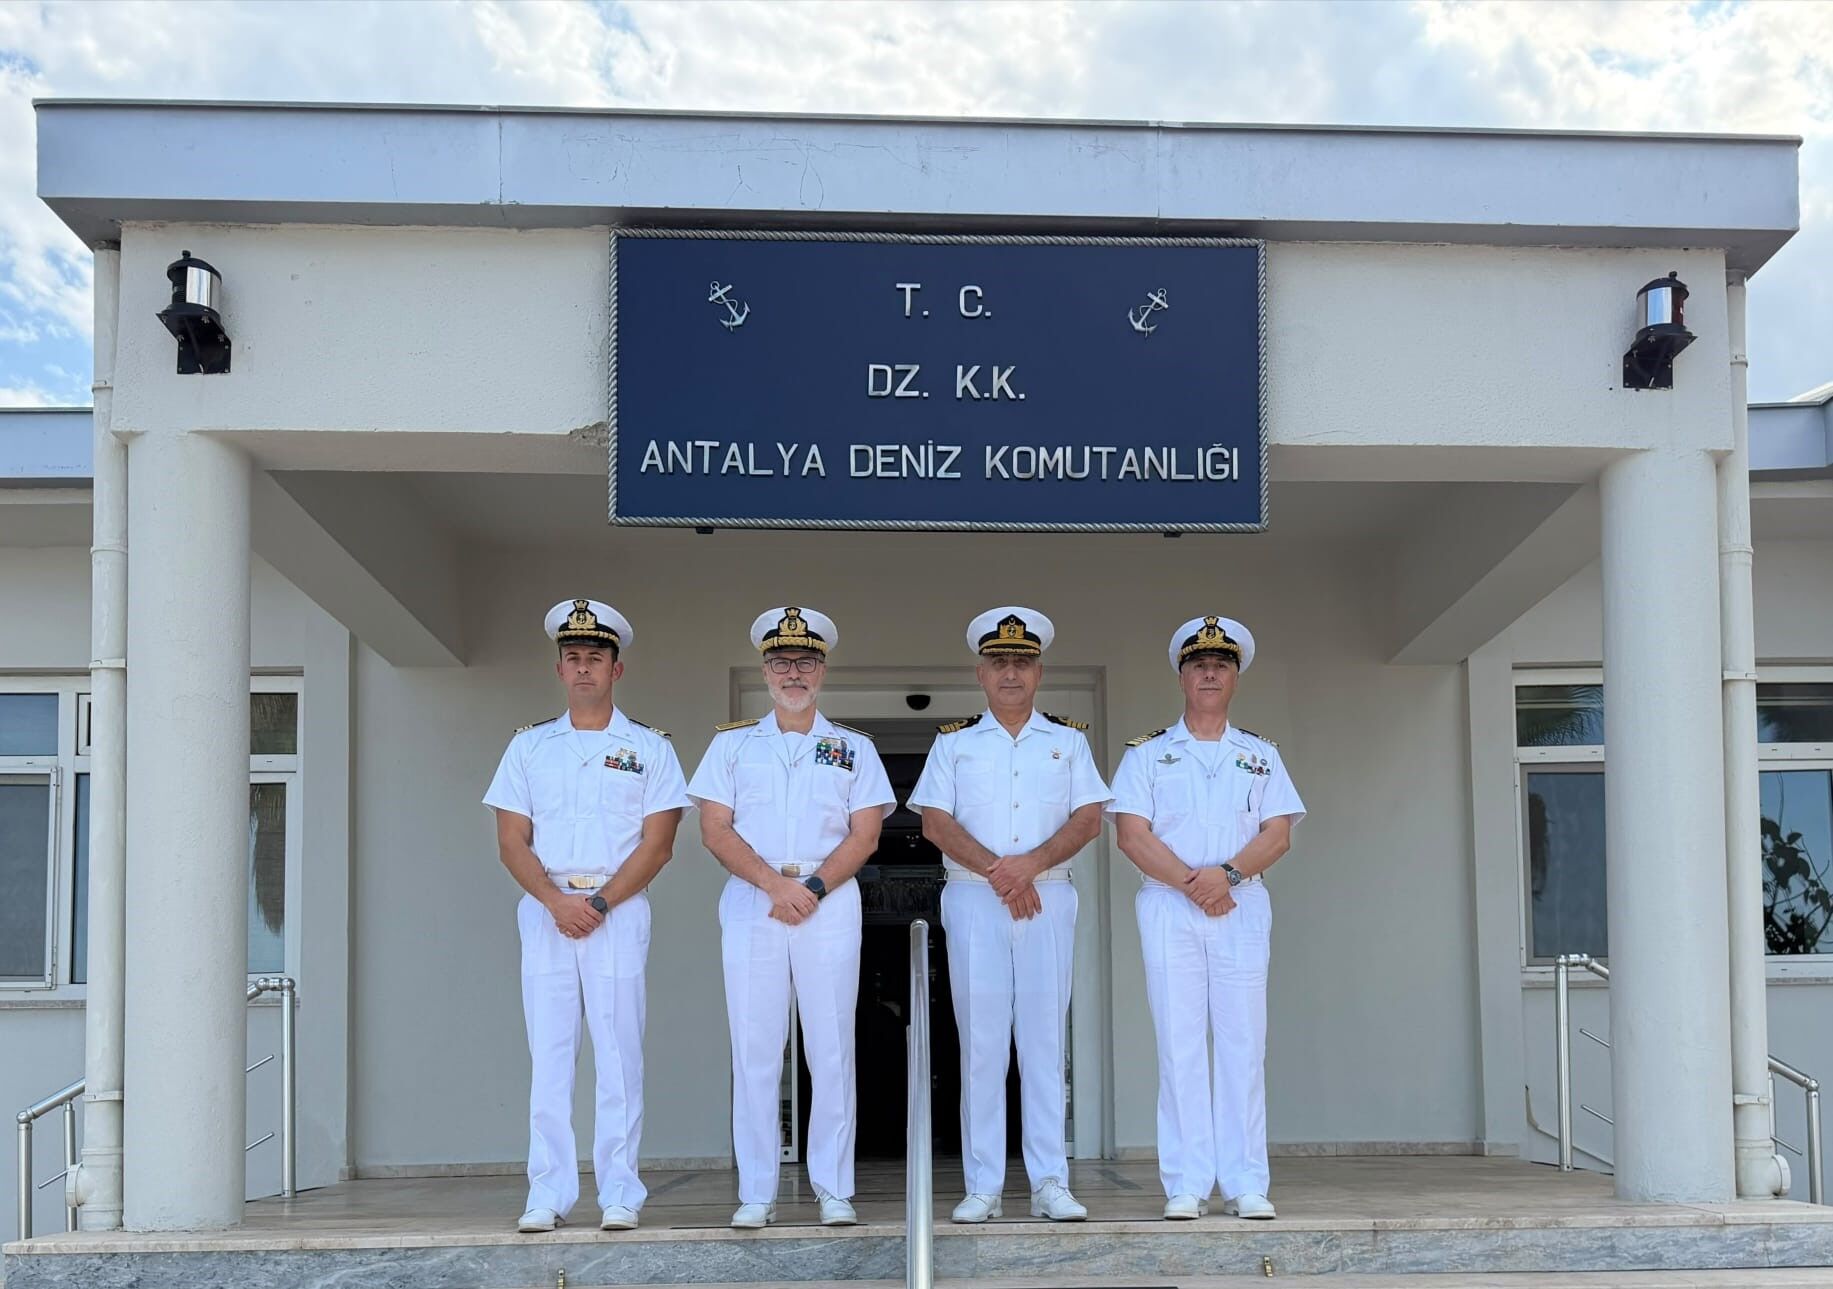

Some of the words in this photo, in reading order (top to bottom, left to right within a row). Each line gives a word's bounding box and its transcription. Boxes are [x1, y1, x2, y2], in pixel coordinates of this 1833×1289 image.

[895, 283, 930, 317] T.
[958, 285, 992, 318] C.
[867, 364, 929, 398] DZ.
[955, 365, 1026, 400] K.K.
[640, 439, 826, 477] ANTALYA
[849, 439, 962, 479] DENİZ
[985, 443, 1239, 482] KOMUTANLIĞI
